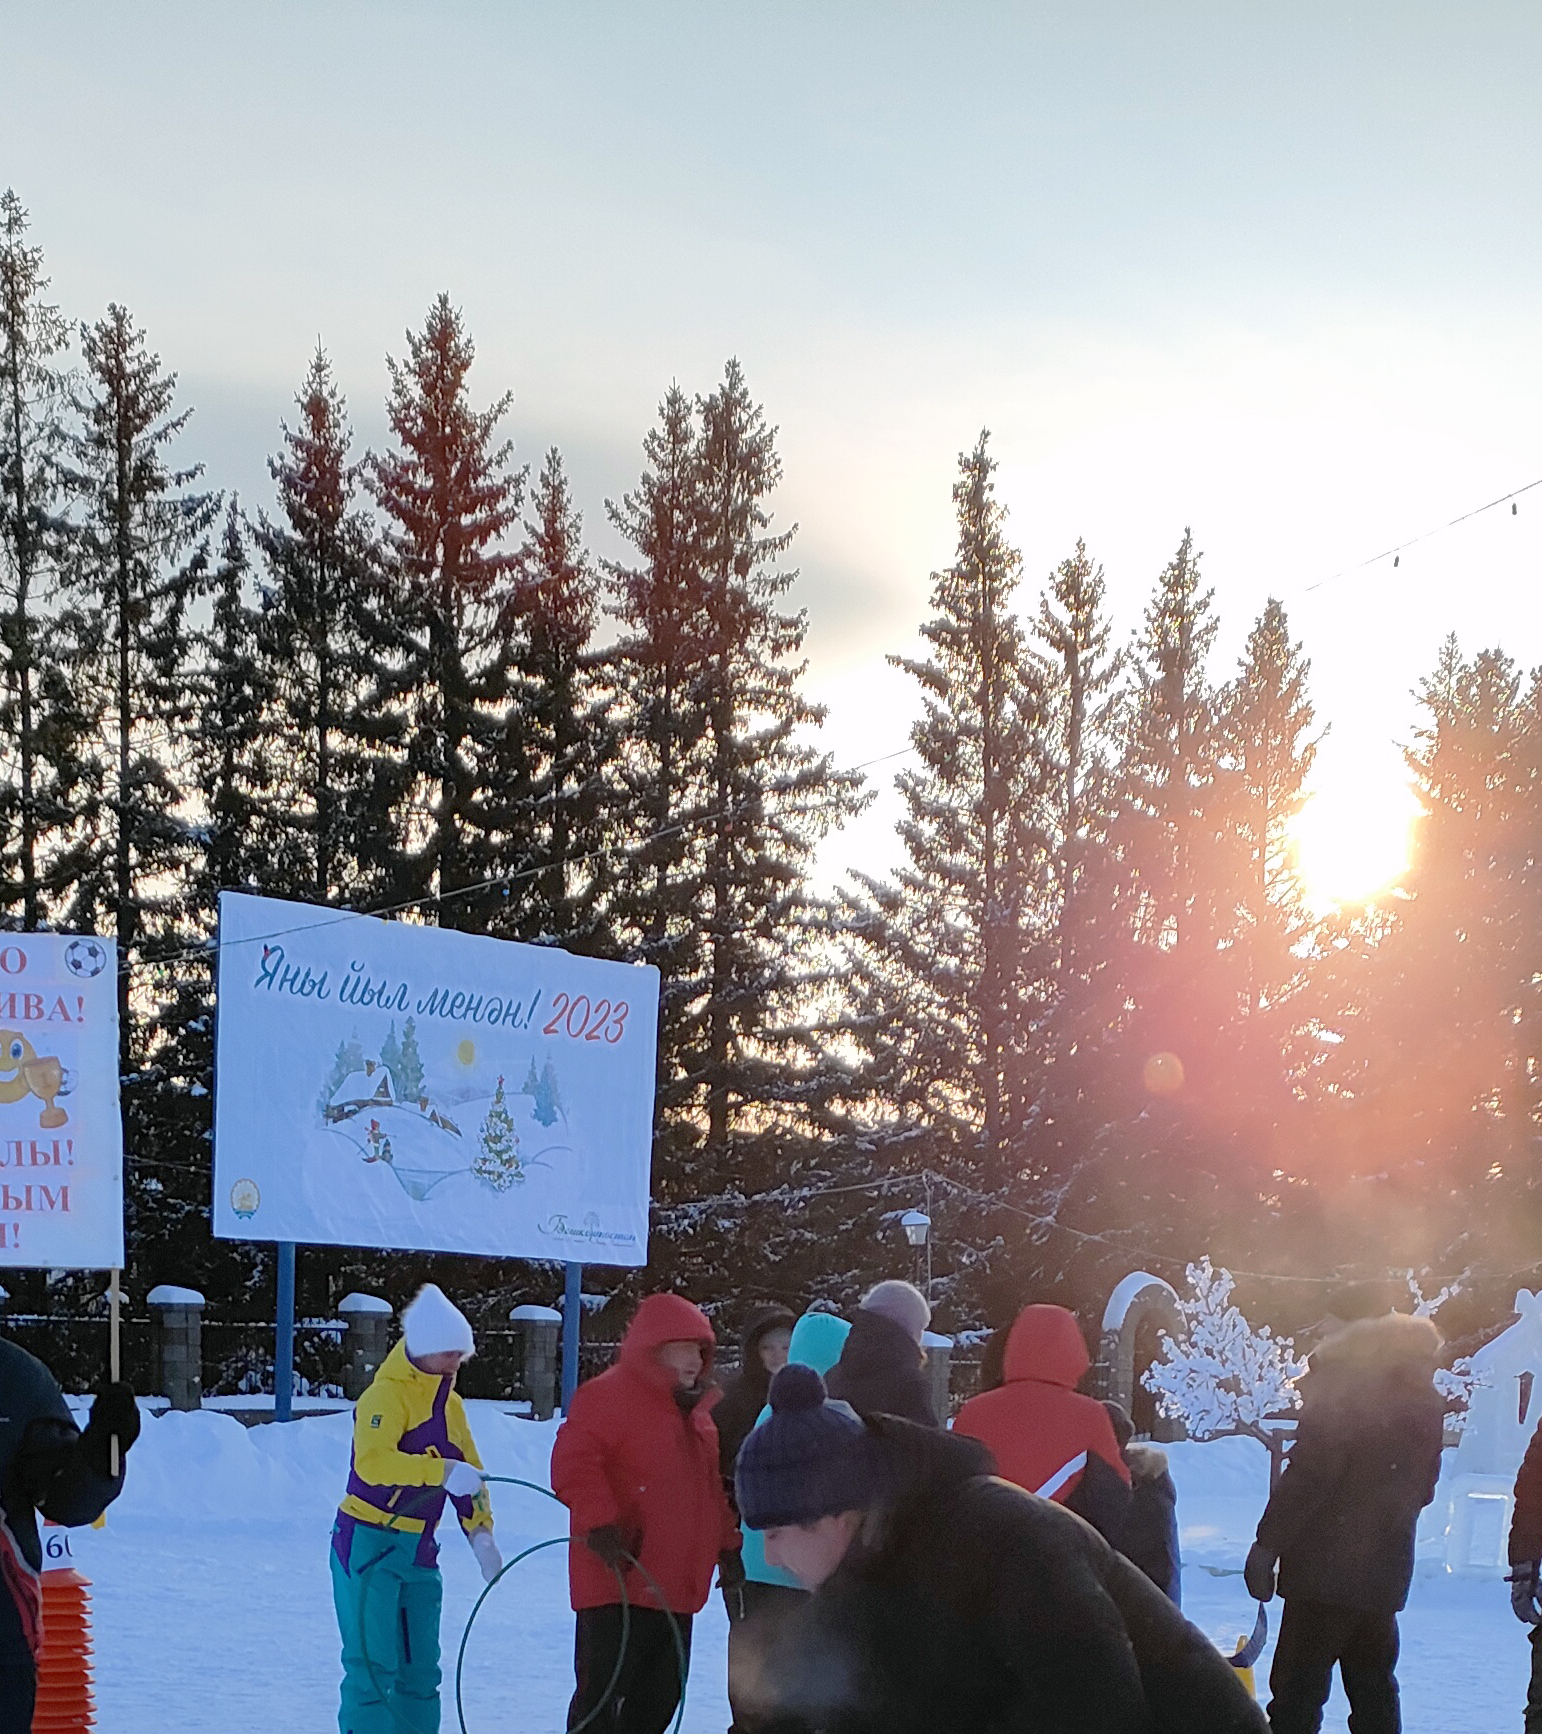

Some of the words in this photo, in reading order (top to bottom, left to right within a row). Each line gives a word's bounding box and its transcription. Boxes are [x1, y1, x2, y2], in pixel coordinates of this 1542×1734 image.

[254, 942, 332, 1000] Яны
[339, 960, 410, 1012] йыл
[416, 988, 542, 1031] менән!
[542, 991, 630, 1044] 2023
